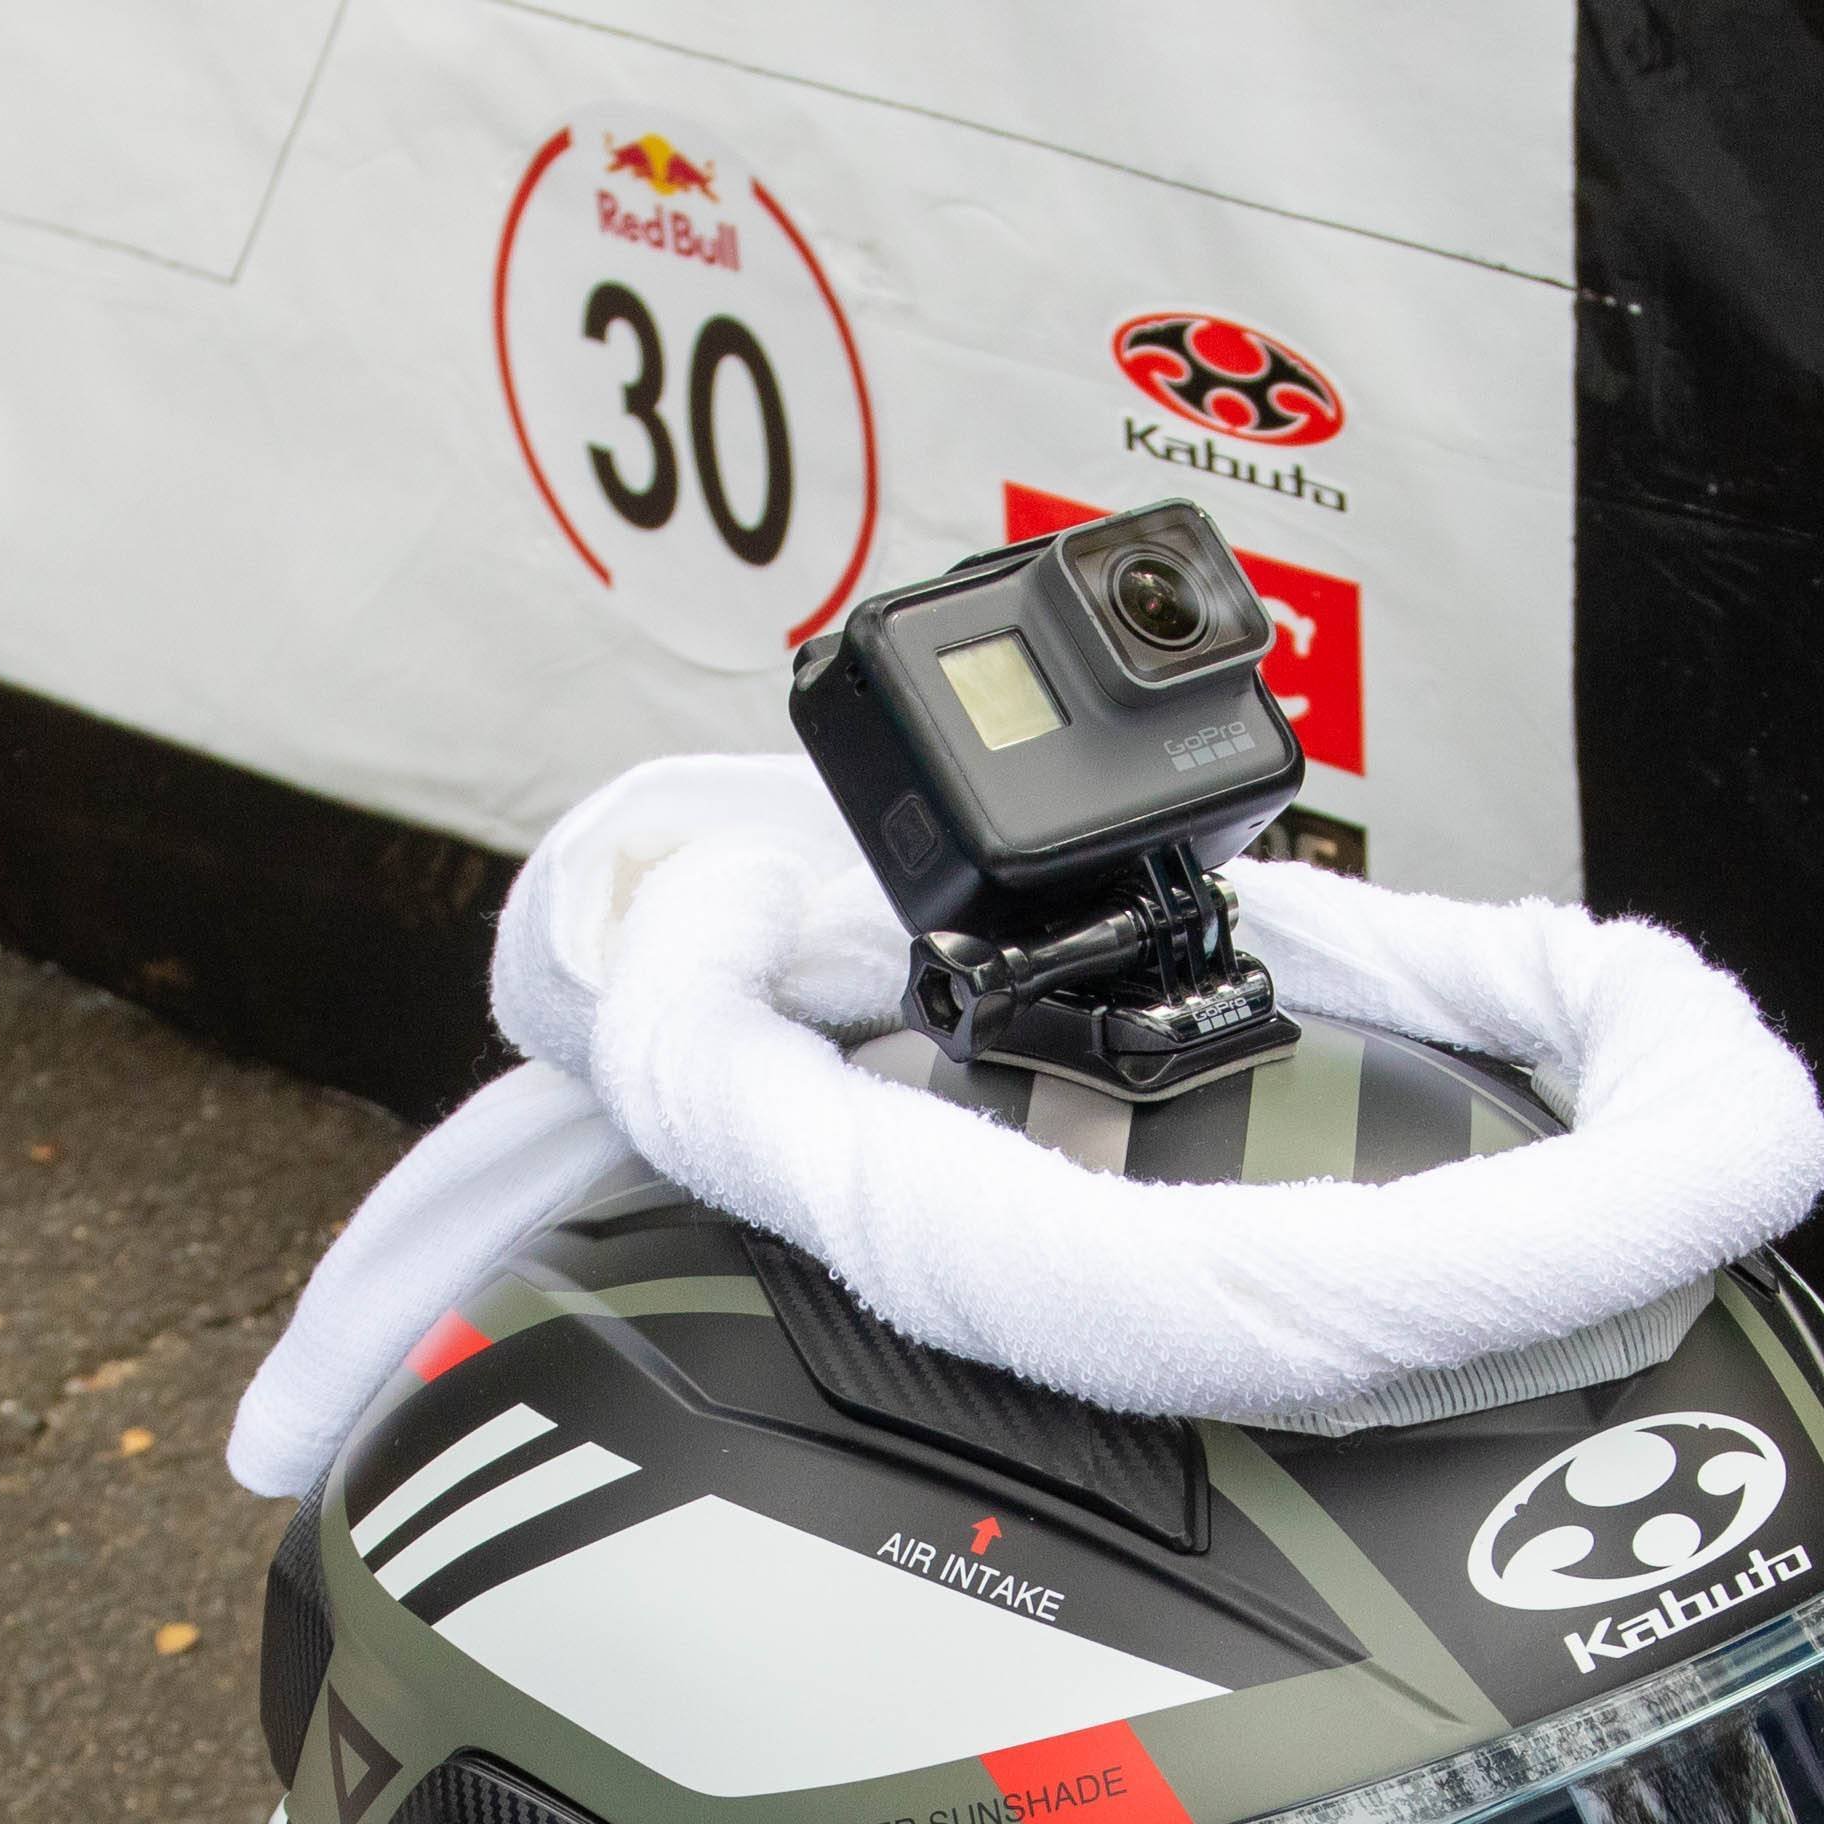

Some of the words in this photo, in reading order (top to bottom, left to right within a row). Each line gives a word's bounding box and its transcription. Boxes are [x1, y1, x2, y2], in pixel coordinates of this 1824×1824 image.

[596, 187, 666, 250] Red
[670, 209, 741, 273] Bull
[582, 281, 792, 568] 30
[1122, 416, 1347, 513] Kabuto
[1163, 720, 1246, 757] GoPro
[1191, 996, 1248, 1022] GoPro
[876, 1532, 937, 1574] AIR
[939, 1553, 1065, 1622] INTAKE
[1563, 1544, 1813, 1675] Kabuto
